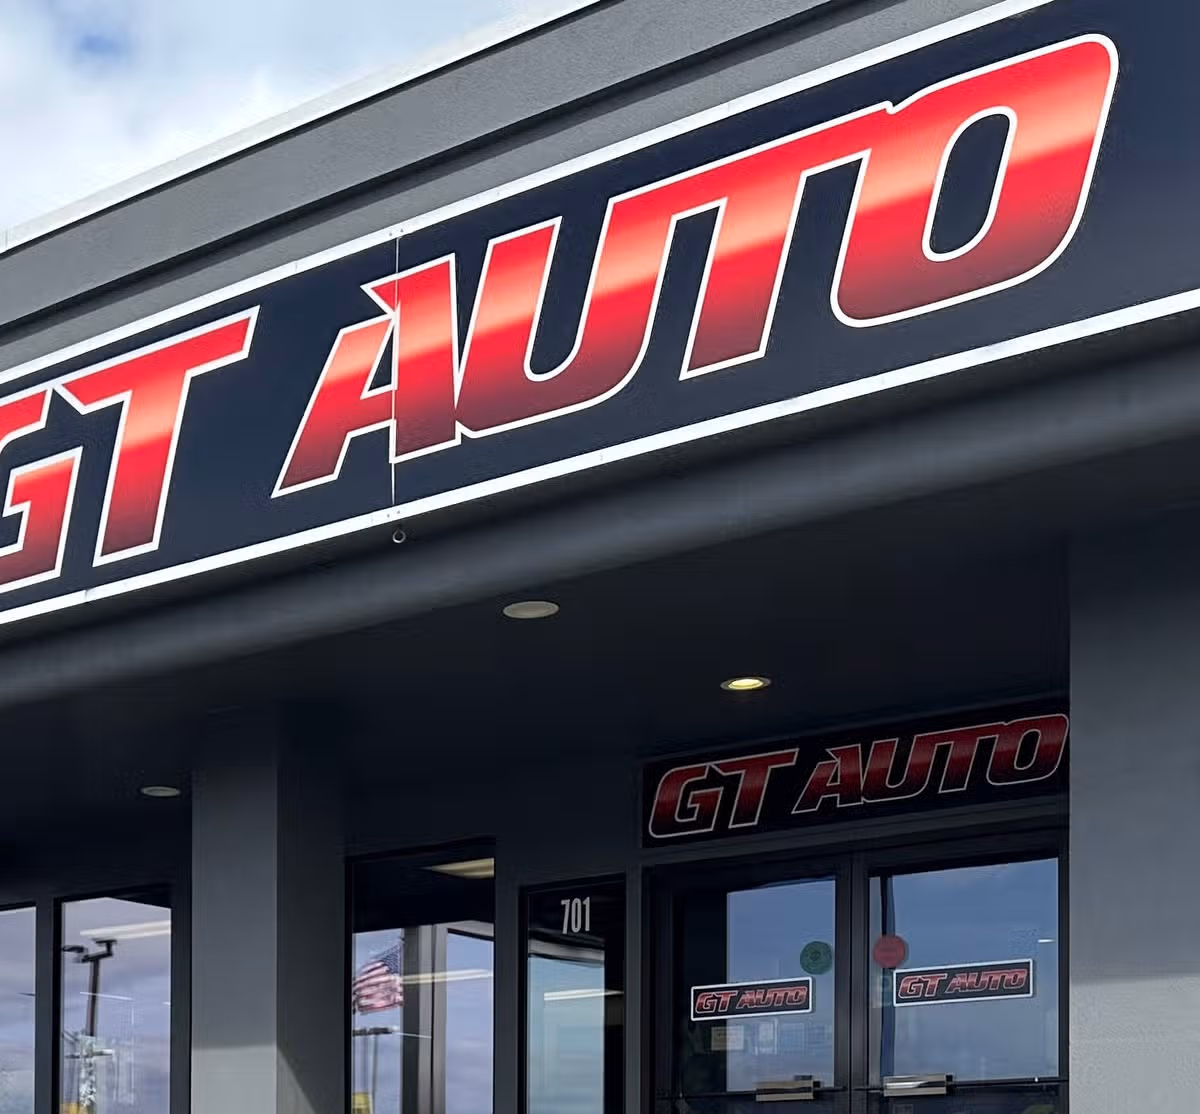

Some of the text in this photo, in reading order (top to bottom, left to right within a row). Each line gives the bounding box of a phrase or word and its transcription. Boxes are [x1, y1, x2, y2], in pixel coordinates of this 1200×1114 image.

[272, 33, 1119, 499] AUTO
[648, 714, 1068, 838] GT AUTO
[560, 896, 591, 934] 701
[696, 985, 808, 1014] GT AUTO
[898, 968, 1028, 998] GT AUTO
